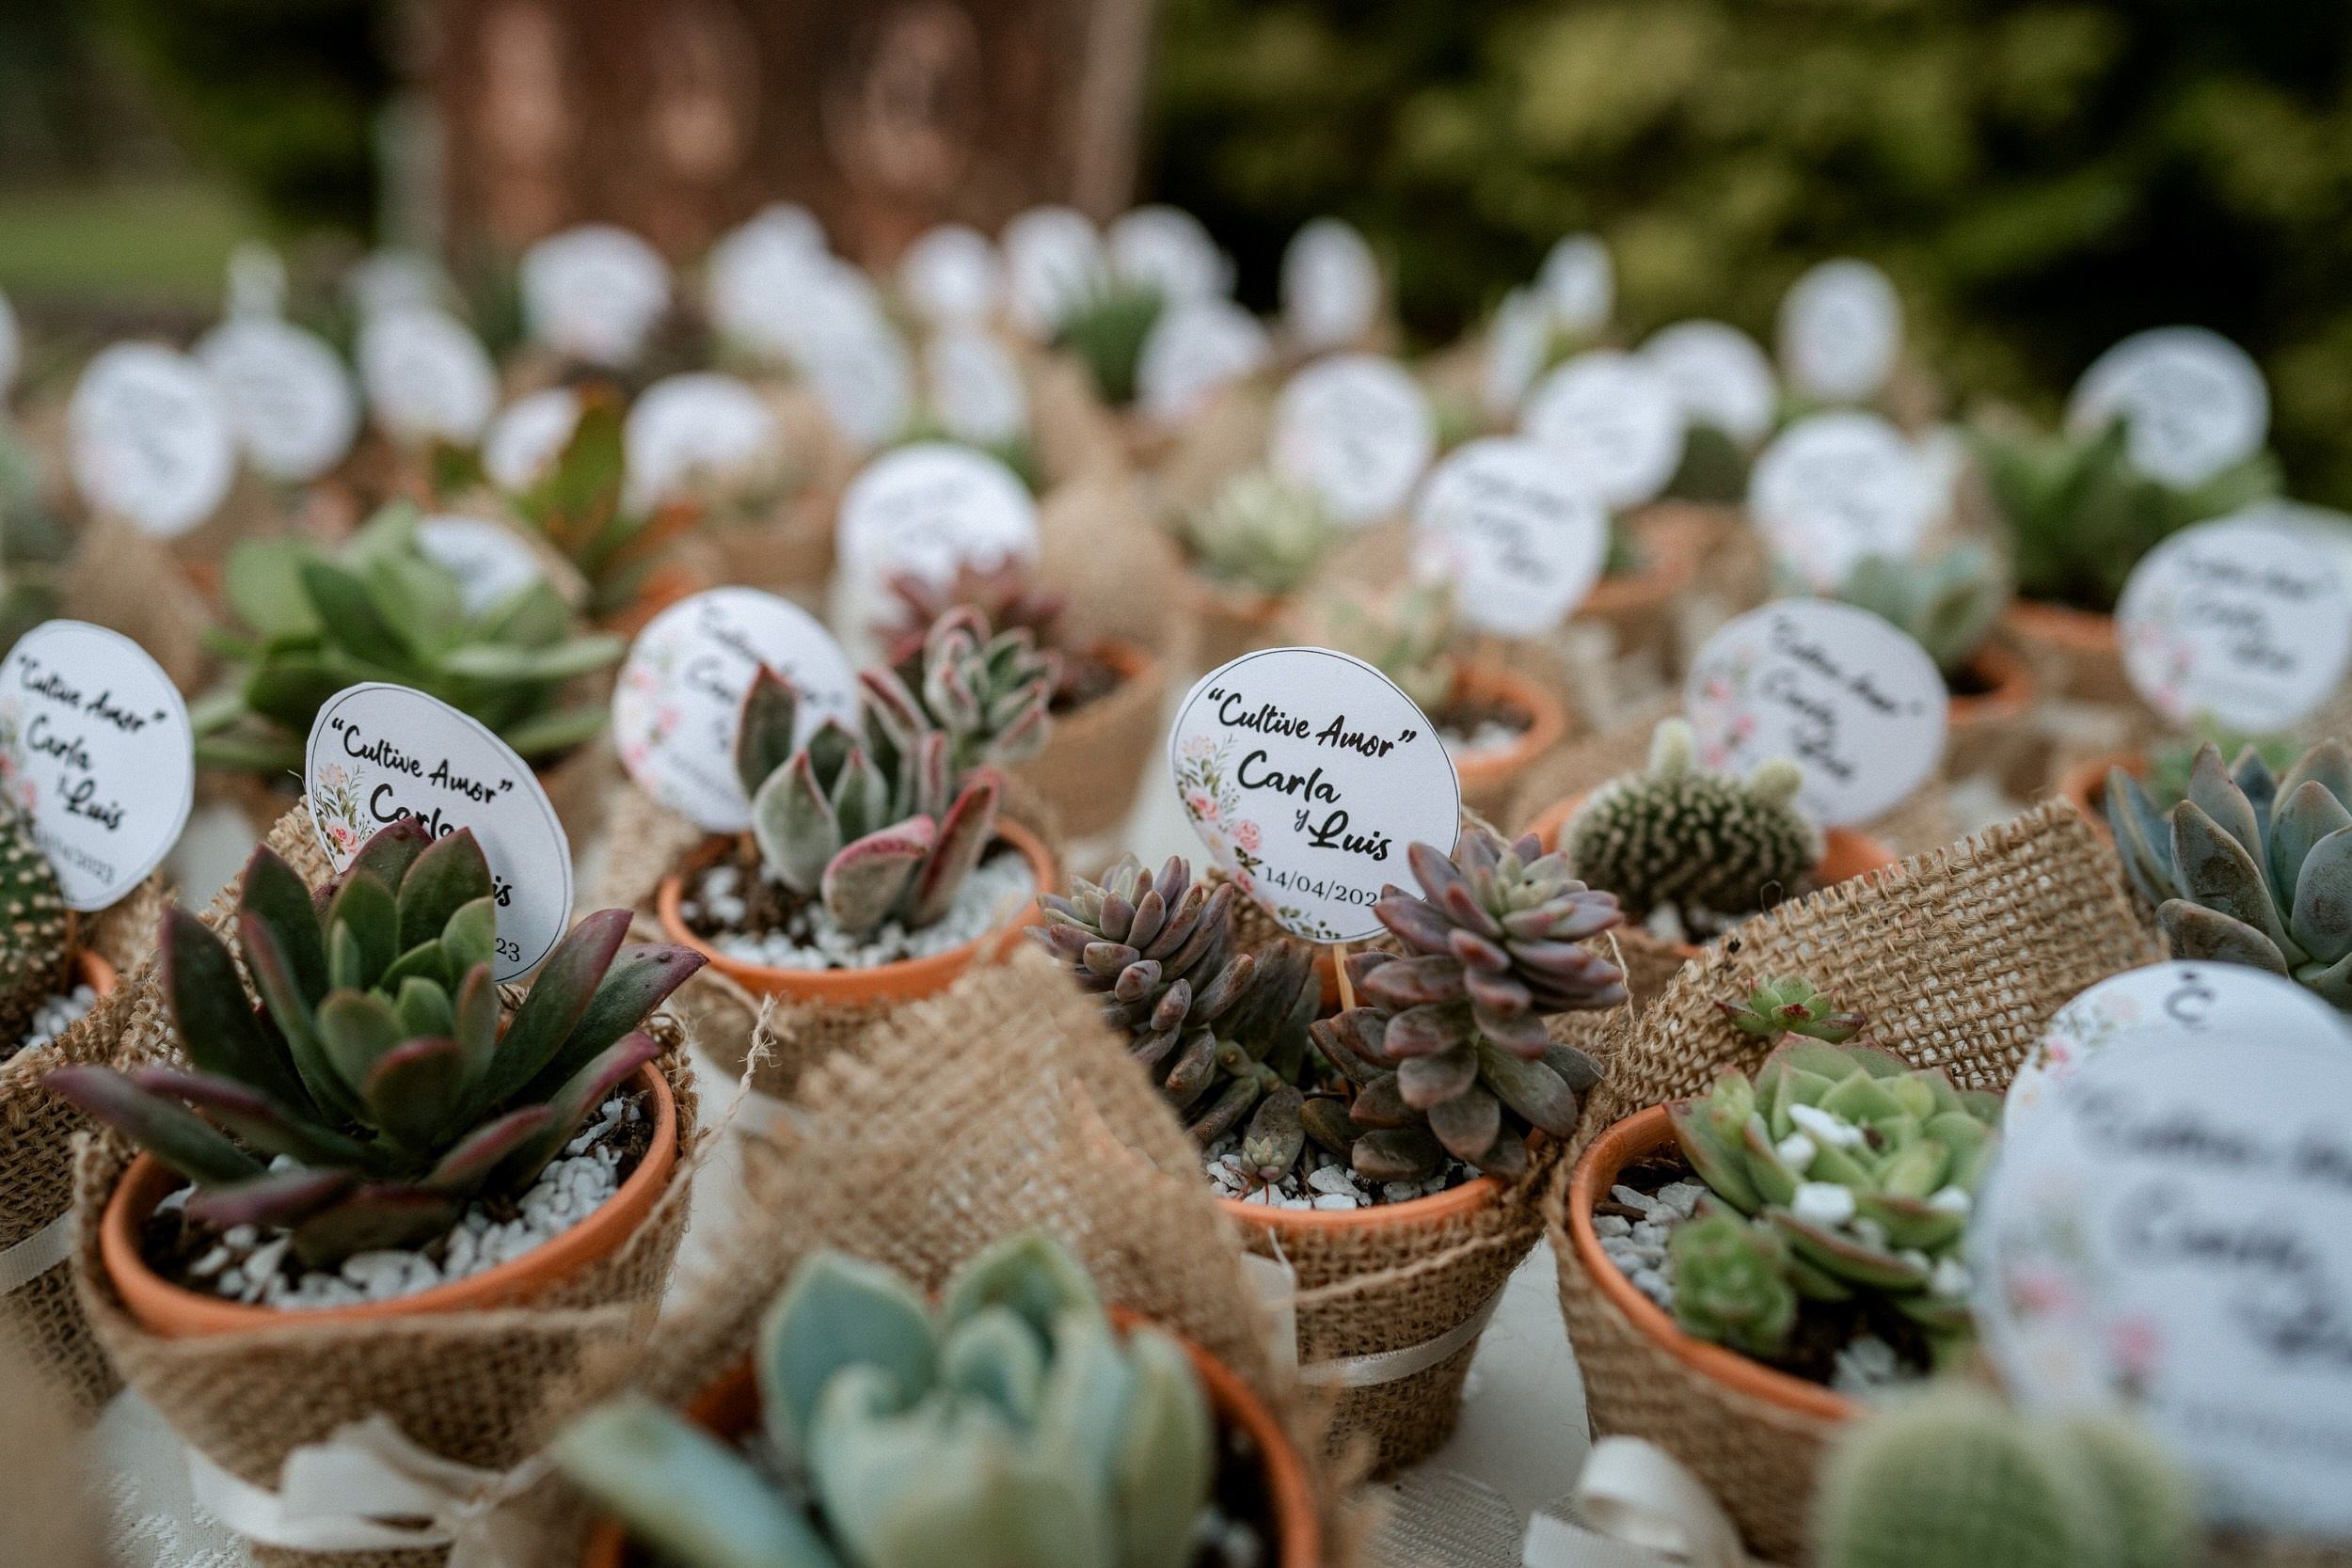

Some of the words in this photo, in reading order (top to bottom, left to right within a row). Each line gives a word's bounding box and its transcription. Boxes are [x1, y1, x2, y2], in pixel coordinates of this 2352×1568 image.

[26, 713, 93, 771] Carla
[1208, 688, 1311, 739] “Cultive
[1315, 715, 1418, 758] Amor”
[331, 718, 422, 778] “Cultive
[428, 758, 513, 803] Amor”
[1237, 750, 1342, 804] Carla
[1295, 809, 1311, 832] y
[1308, 810, 1393, 862] Luis
[492, 876, 513, 908] is
[1265, 865, 1378, 908] 14/04/202
